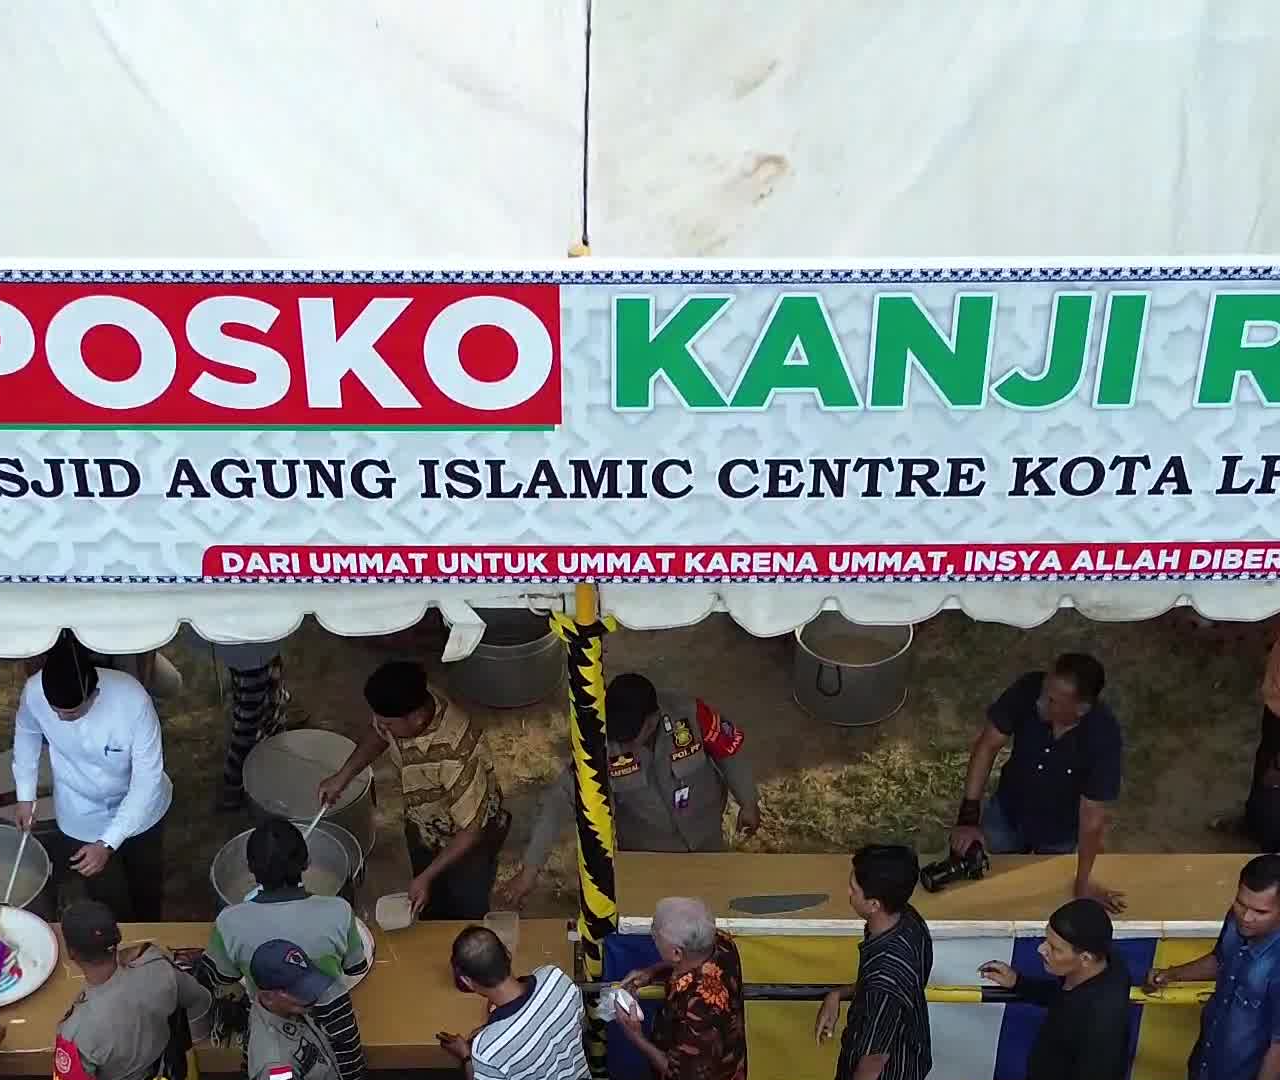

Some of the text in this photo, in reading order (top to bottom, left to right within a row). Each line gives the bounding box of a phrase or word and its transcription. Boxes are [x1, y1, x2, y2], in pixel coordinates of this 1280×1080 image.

[612, 291, 1151, 409] KANJI
[166, 458, 397, 499] AGUNG
[419, 459, 693, 499] ISLAMIC
[717, 457, 987, 498] CENTRE
[1008, 455, 1193, 496] KOTA
[221, 552, 301, 574] DARI
[309, 552, 428, 574] UMMAT
[437, 552, 549, 574] UNTUK
[557, 552, 676, 574] UMMAT
[685, 552, 818, 574] KARENA
[829, 551, 954, 575] UMMAT,
[965, 550, 1063, 572] INSYA
[1073, 550, 1180, 572] ALLAH
